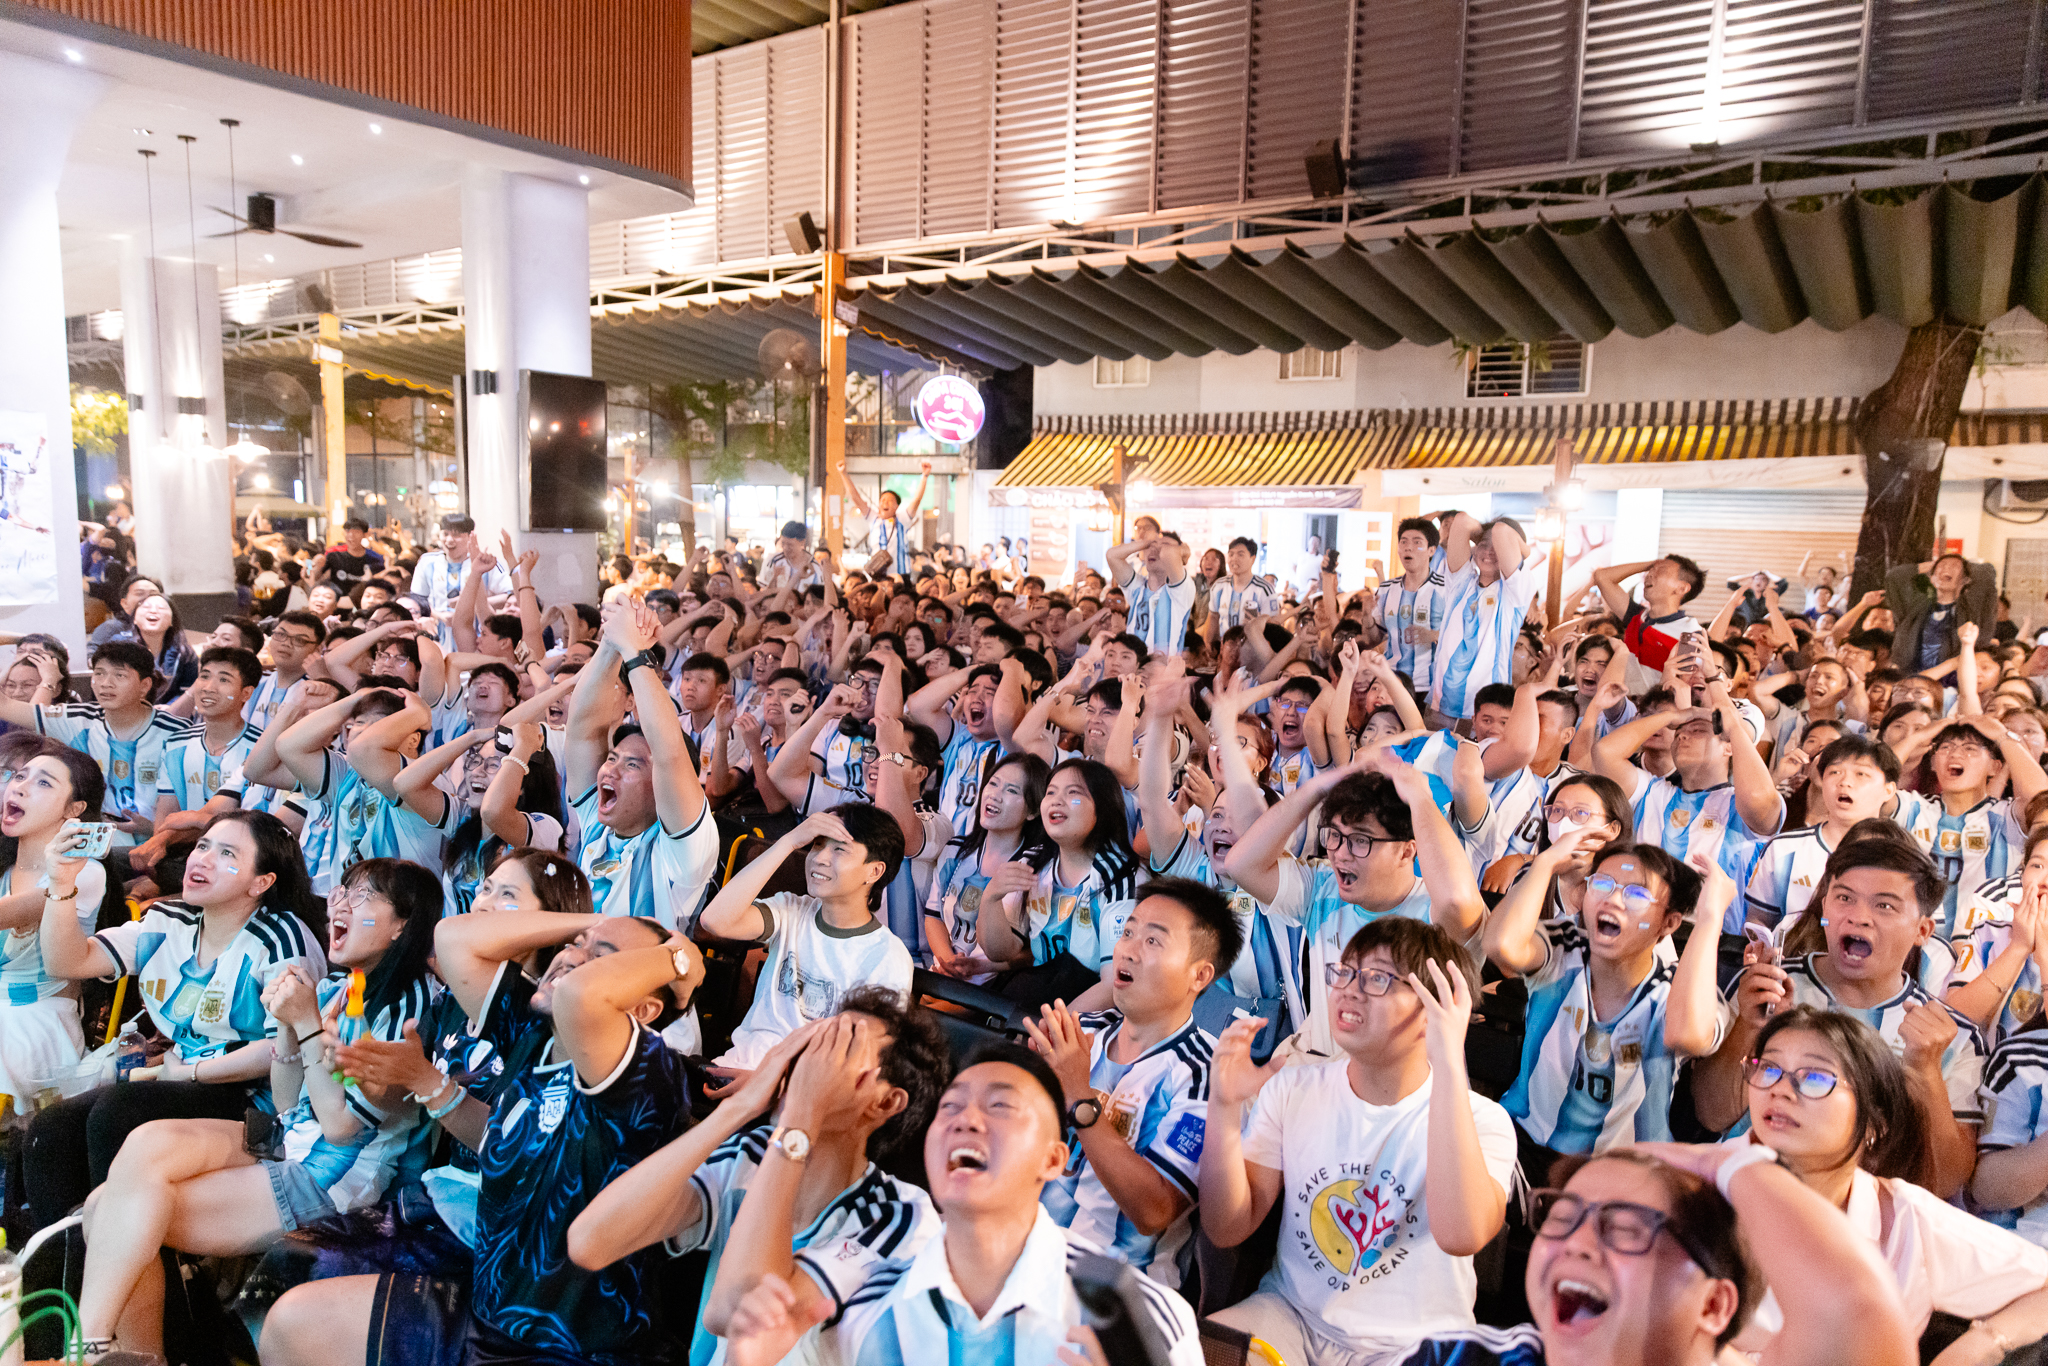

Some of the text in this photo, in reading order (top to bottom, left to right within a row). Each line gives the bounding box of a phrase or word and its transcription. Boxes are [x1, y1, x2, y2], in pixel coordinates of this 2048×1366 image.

[1462, 475, 1506, 488] Salon
[844, 762, 863, 787] 10
[956, 782, 976, 806] 10
[1513, 811, 1542, 843] 10
[1574, 1059, 1613, 1104] 10
[1177, 1133, 1198, 1152] PEACE
[1298, 1167, 1329, 1203] SAVE
[1339, 1162, 1372, 1176] THE
[1296, 1230, 1326, 1272] SAVE
[1360, 1247, 1410, 1285] OCEAN
